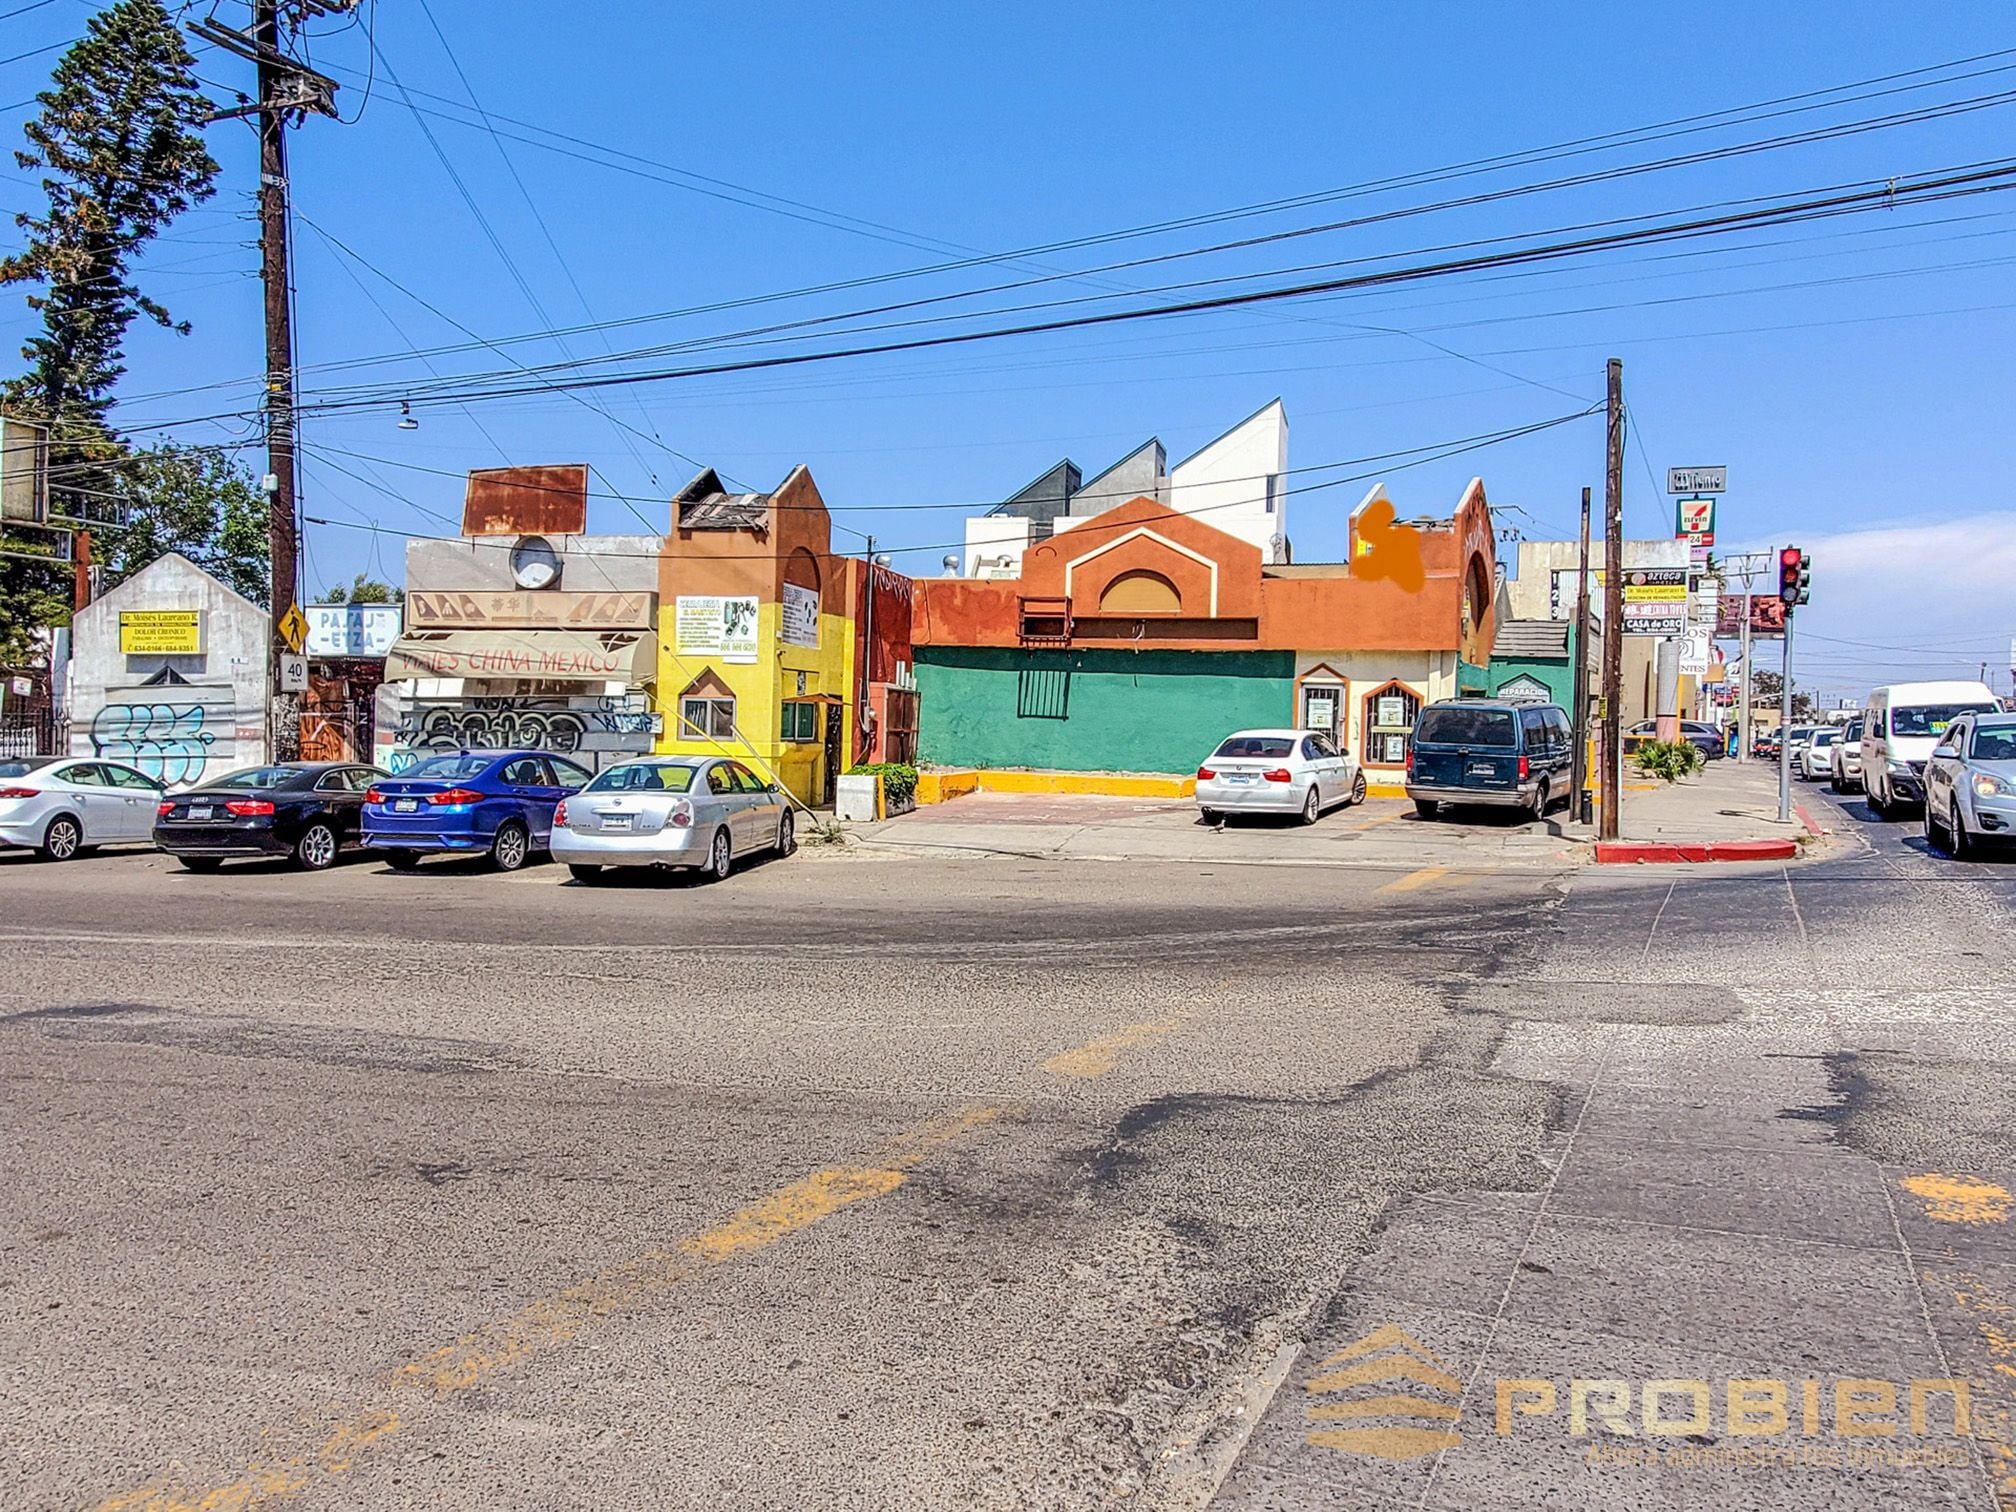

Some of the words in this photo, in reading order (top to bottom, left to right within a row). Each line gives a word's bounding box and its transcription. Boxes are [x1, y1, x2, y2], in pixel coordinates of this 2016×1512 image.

[1690, 535, 1701, 544] 24
[1647, 571, 1681, 581] azteca
[1626, 620, 1649, 629] CASA
[1651, 620, 1661, 629] de
[1662, 619, 1681, 629] ORO
[468, 649, 531, 672] CHINA
[538, 651, 620, 674] MEXICO
[287, 663, 303, 678] 40
